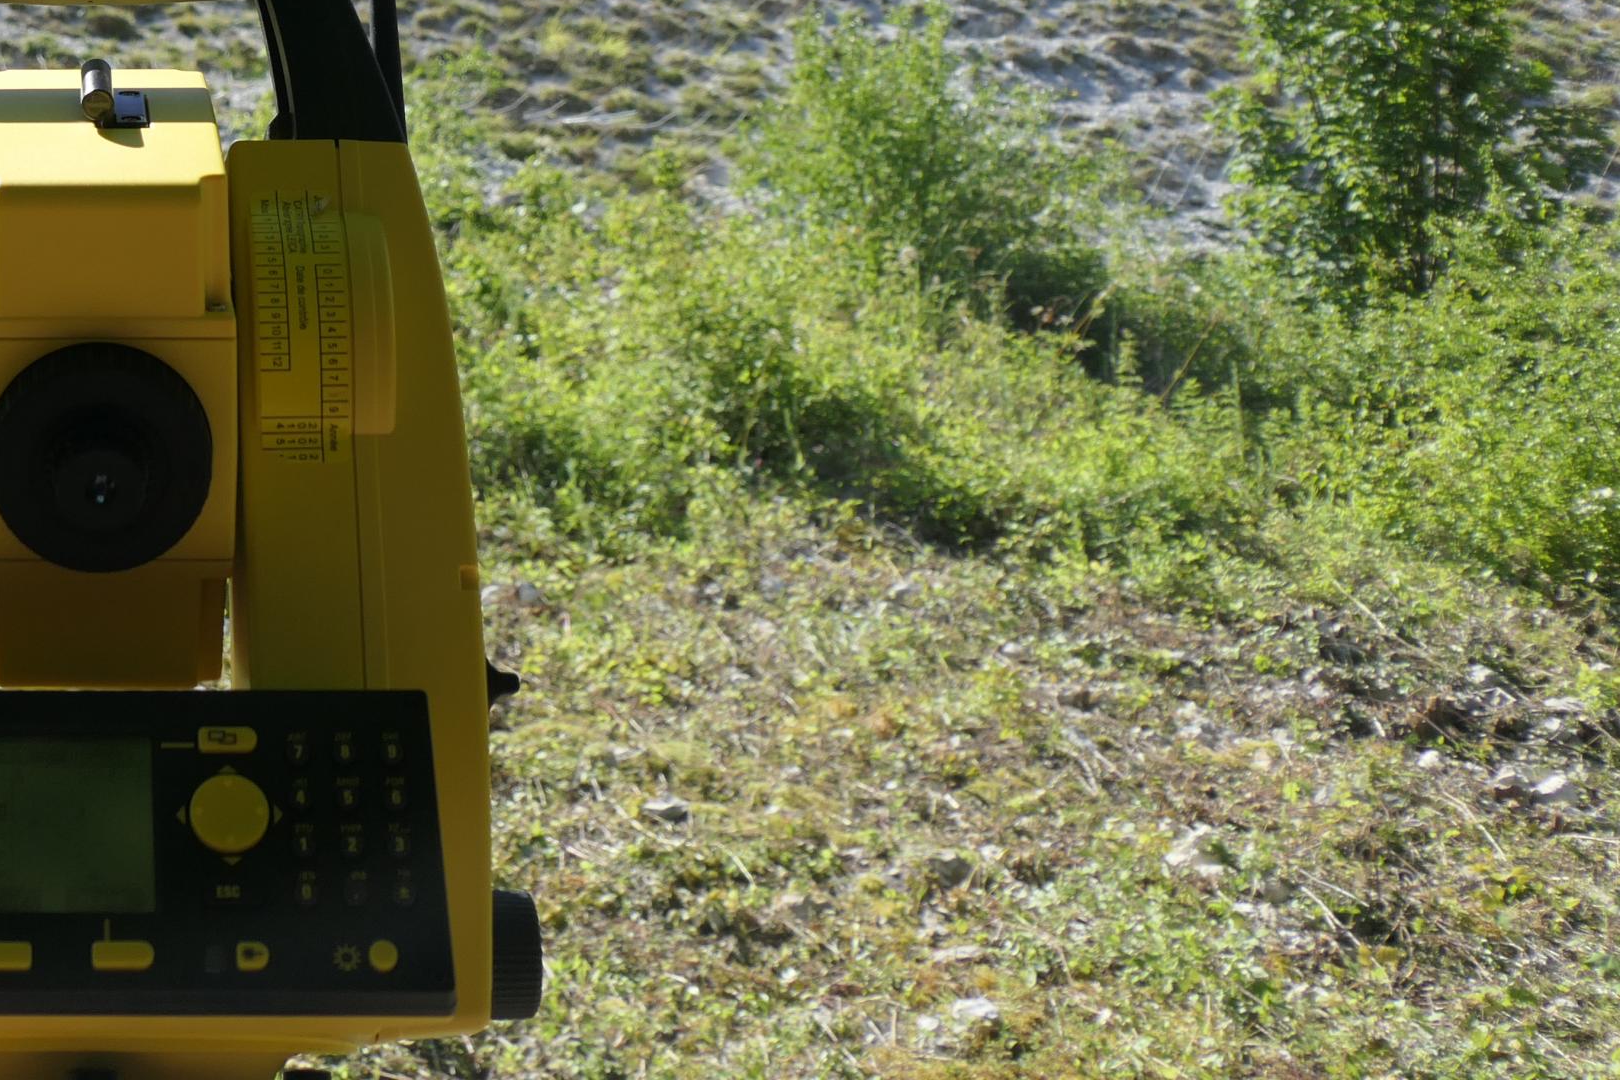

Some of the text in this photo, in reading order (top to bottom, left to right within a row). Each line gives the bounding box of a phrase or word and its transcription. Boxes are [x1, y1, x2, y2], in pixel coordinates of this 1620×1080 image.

[297, 285, 305, 294] de
[271, 325, 282, 336] 10
[272, 341, 282, 350] 11
[272, 356, 283, 368] 12
[328, 358, 338, 366] 6
[293, 743, 397, 759] 7 8 9
[295, 789, 401, 805] 4 5 6
[299, 836, 405, 852] 1 2 3
[216, 885, 241, 898] ESC
[301, 883, 312, 899] 0
